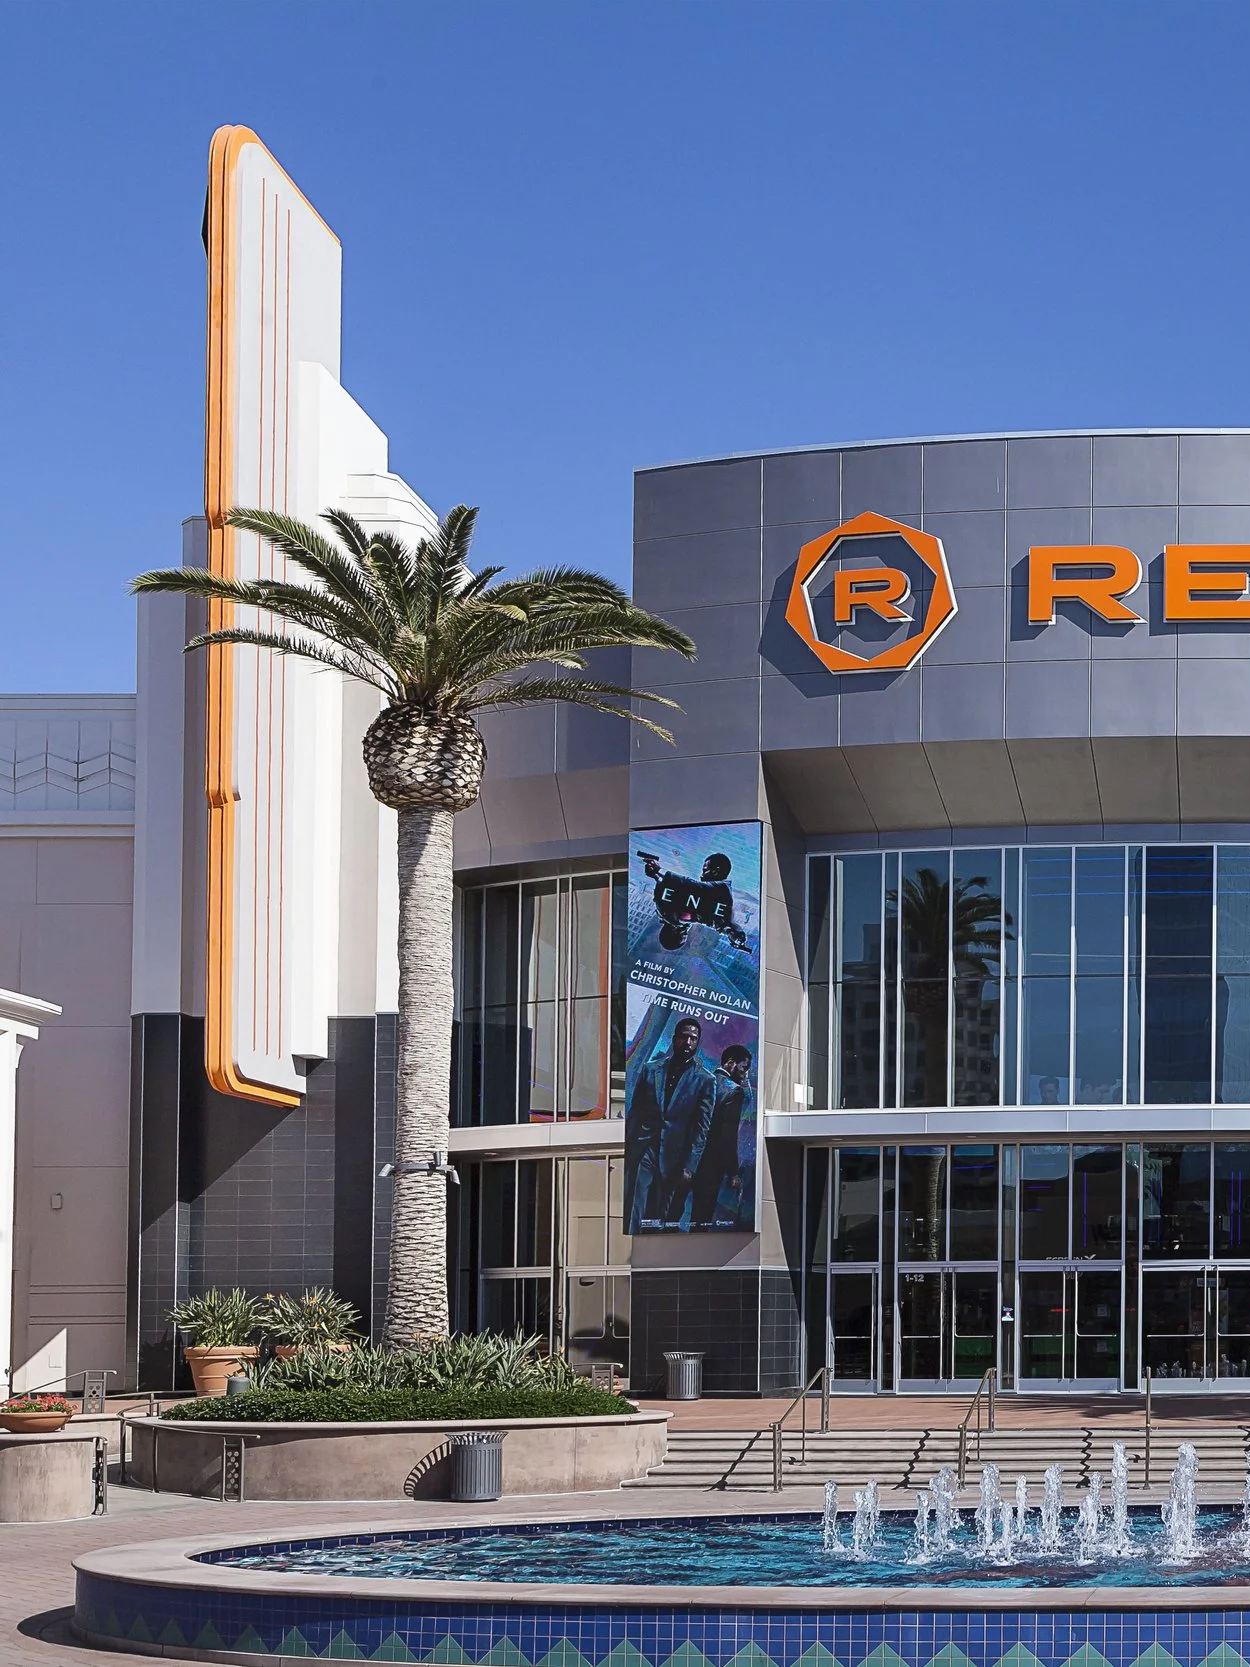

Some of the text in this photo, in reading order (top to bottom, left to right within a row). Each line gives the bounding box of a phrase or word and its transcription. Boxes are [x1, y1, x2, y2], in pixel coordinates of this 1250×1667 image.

[834, 567, 914, 625] R
[635, 959, 675, 975] A FILM BY
[630, 969, 752, 1010] CHRISTOPHER NOLAN
[670, 1000, 702, 1018] RUNS
[704, 1010, 730, 1025] OUT
[905, 1274, 925, 1283] 1-12
